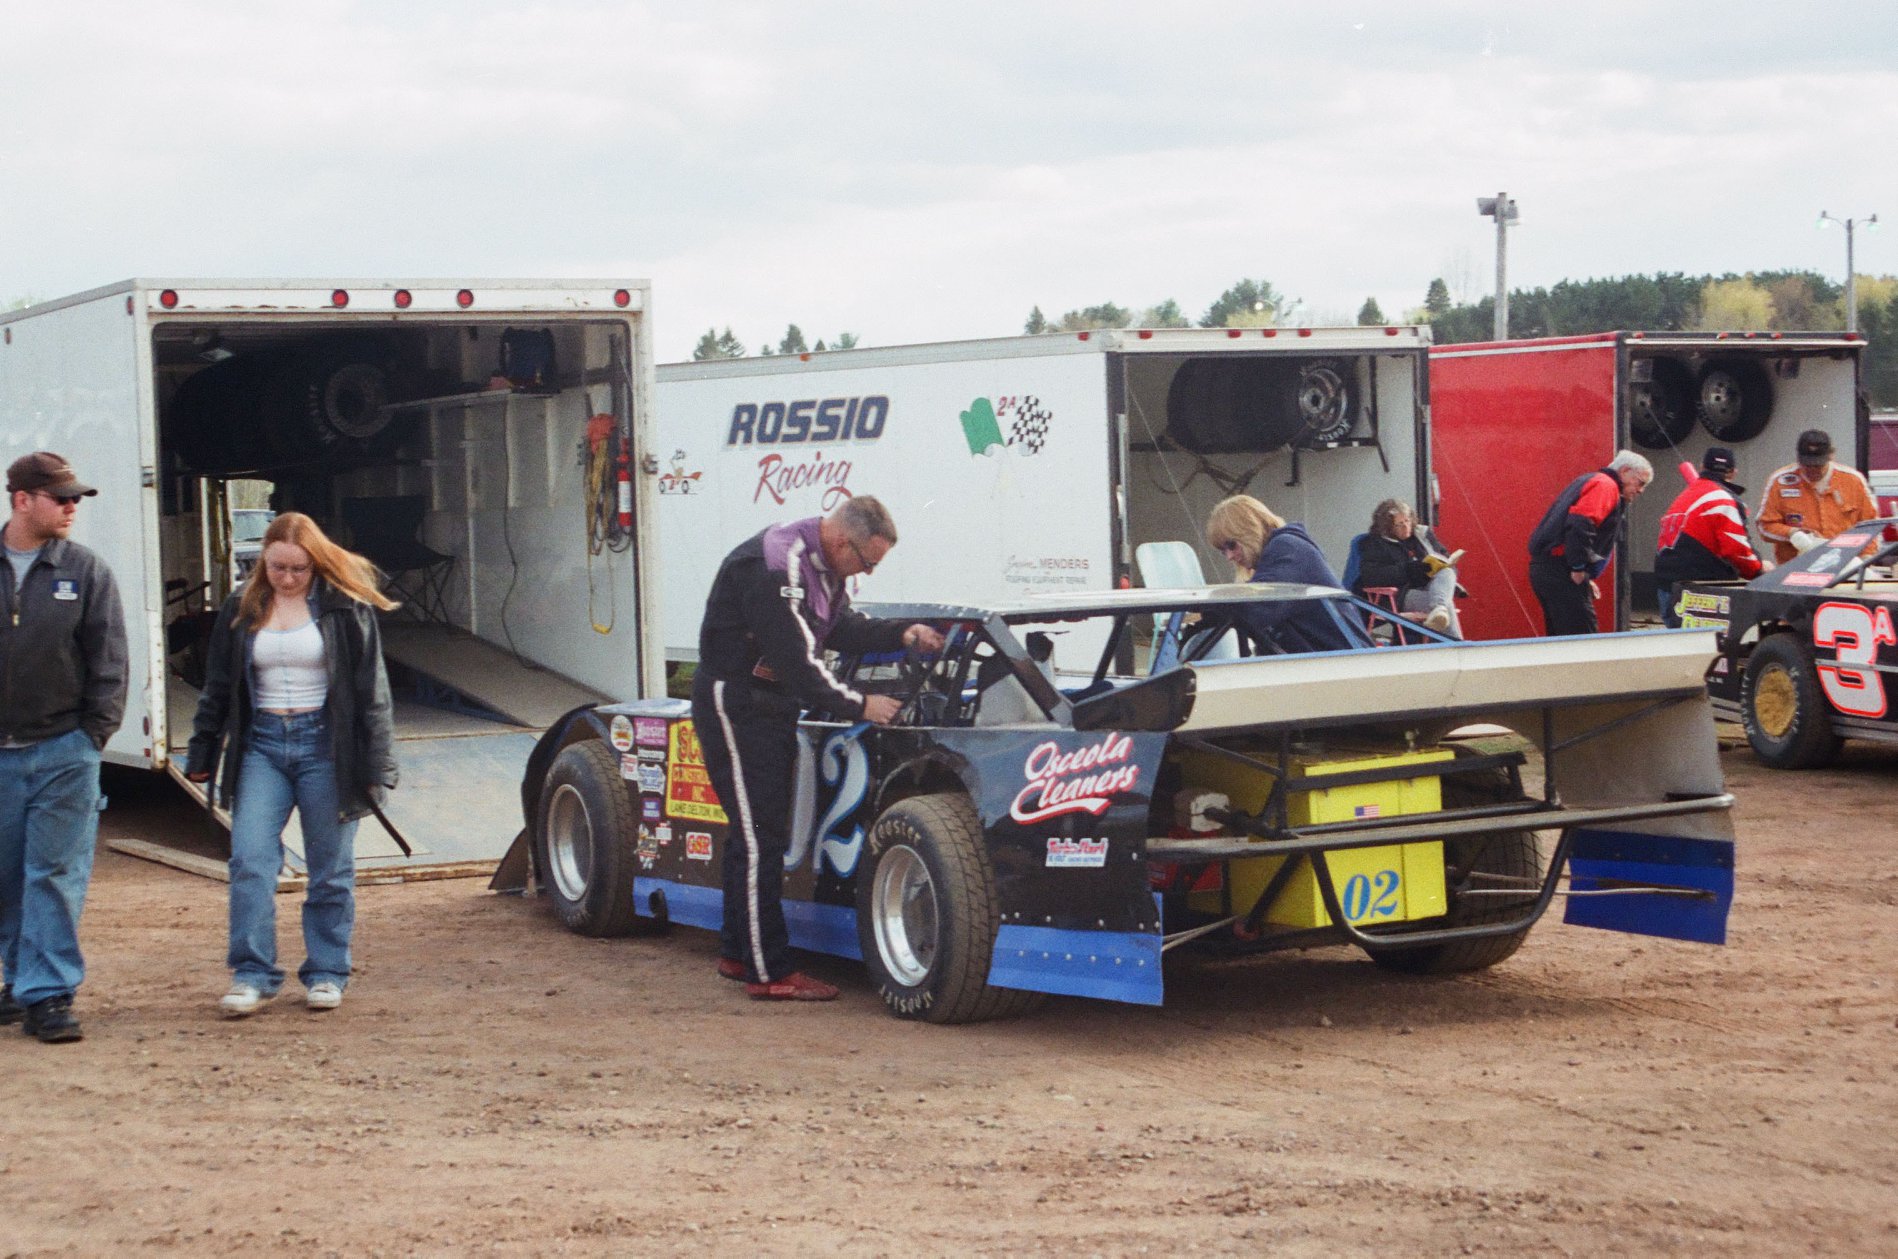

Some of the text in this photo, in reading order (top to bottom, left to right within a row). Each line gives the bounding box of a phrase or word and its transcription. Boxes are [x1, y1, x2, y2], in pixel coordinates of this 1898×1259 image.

[727, 395, 890, 445] ROSSIO
[754, 451, 852, 511] Racing
[1025, 732, 1133, 778] Osceola
[1010, 765, 1140, 825] Cleaners
[1343, 870, 1400, 921] 02
